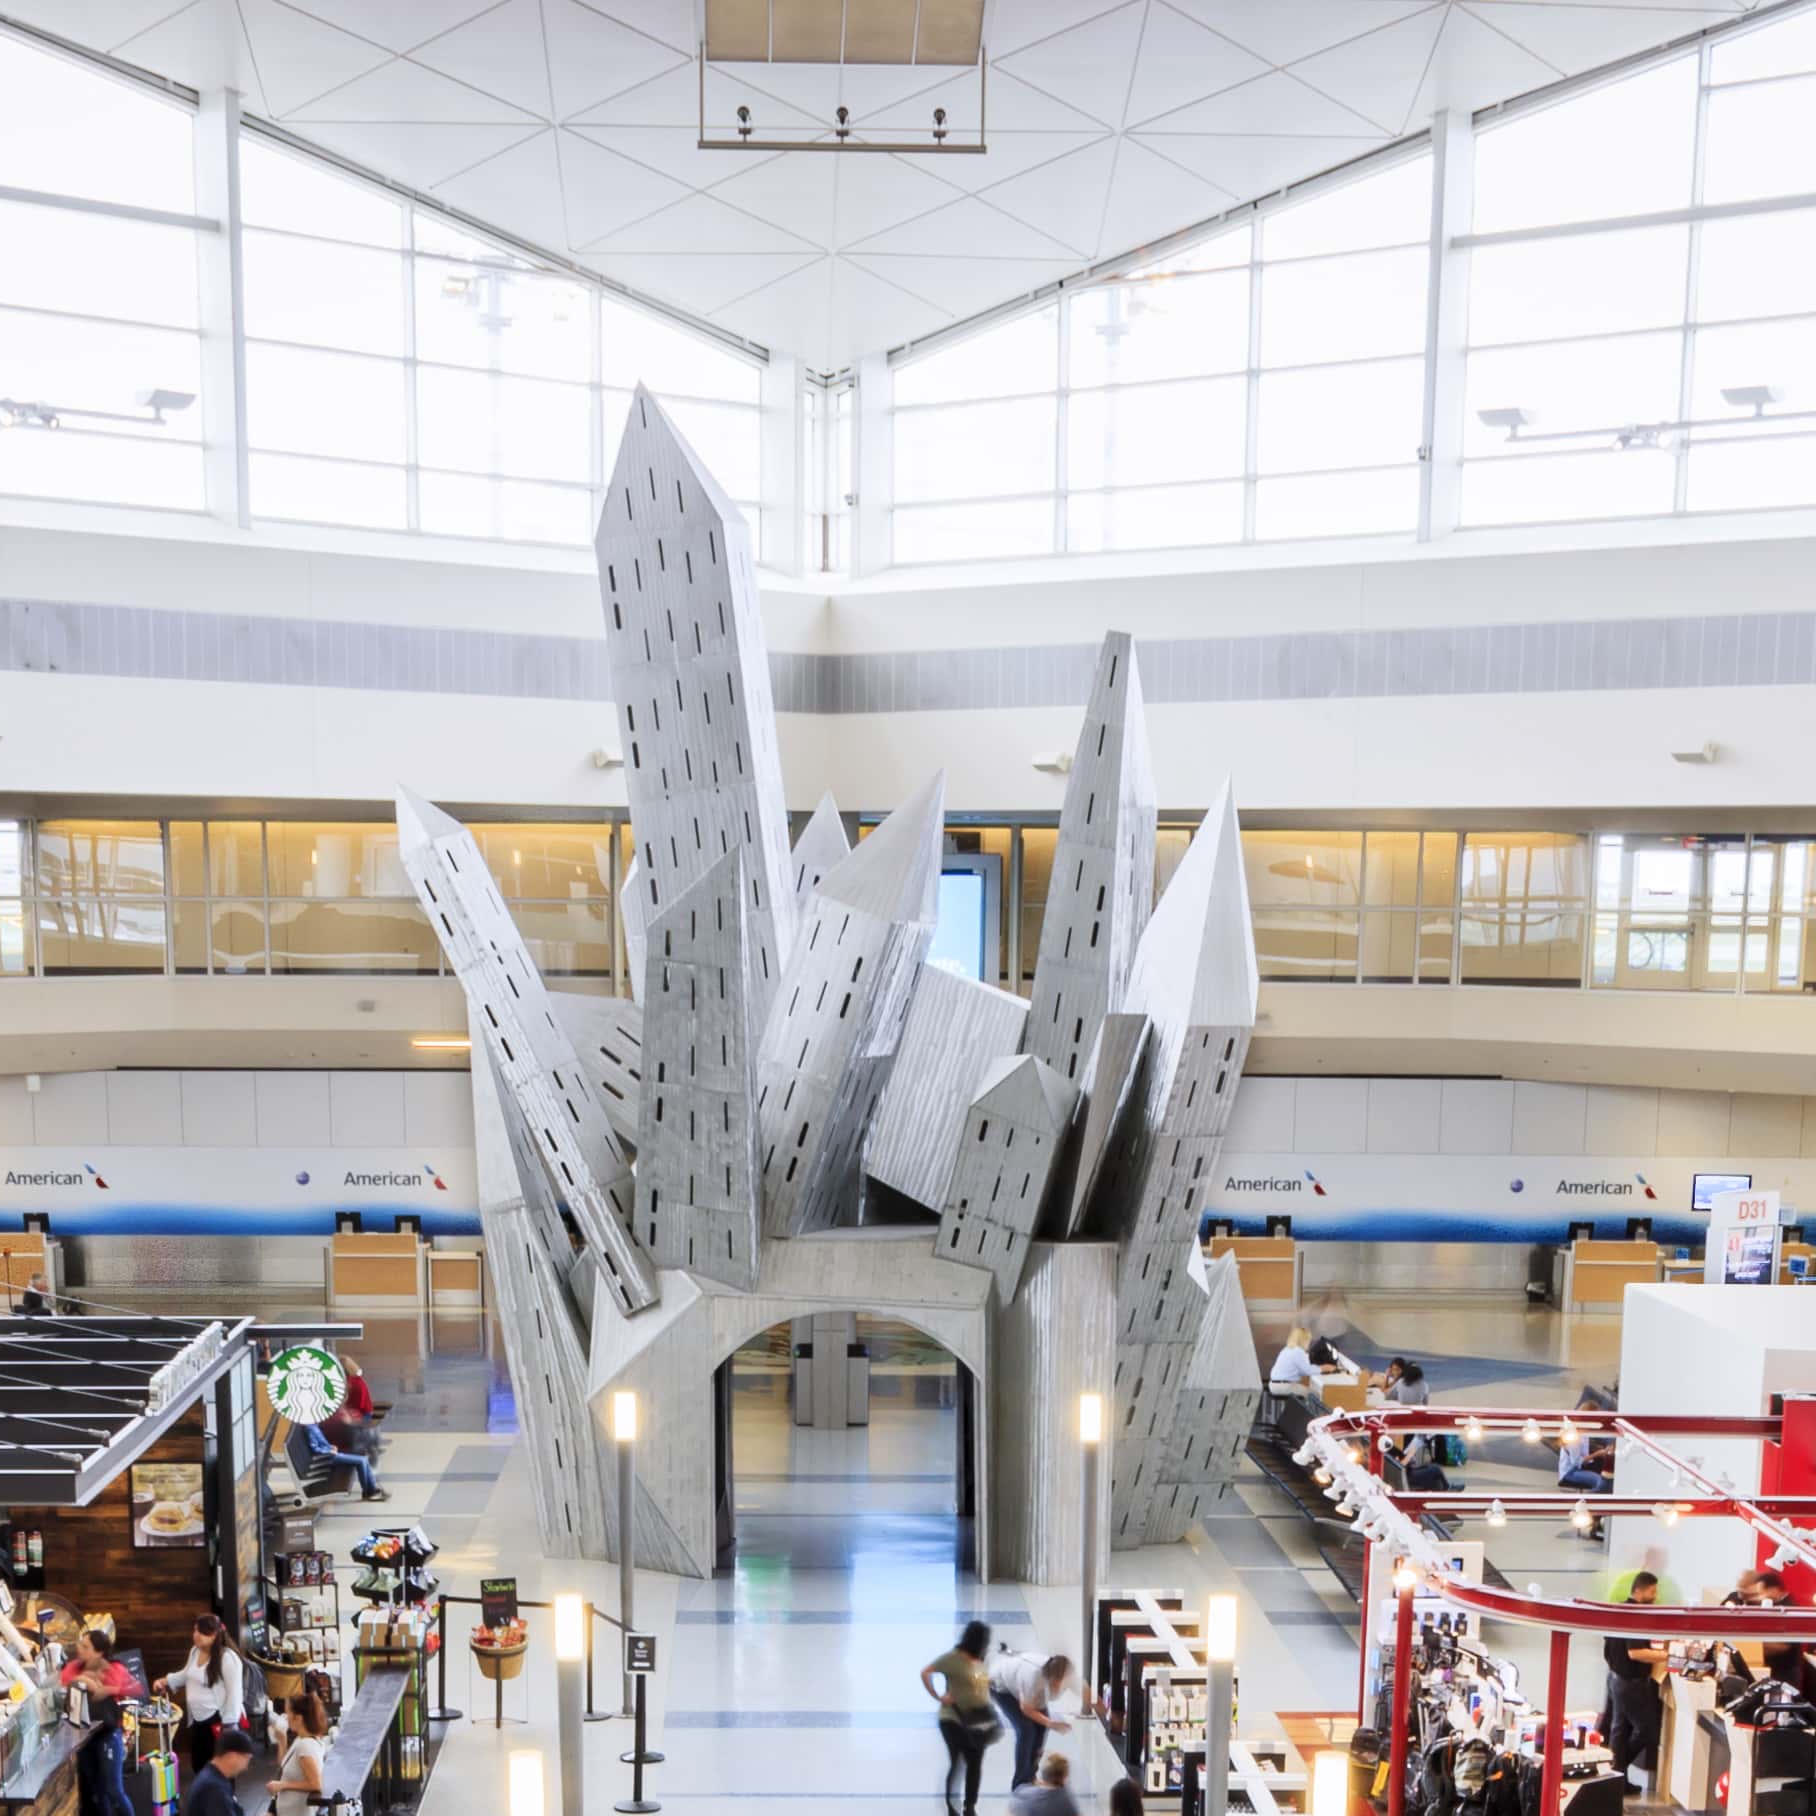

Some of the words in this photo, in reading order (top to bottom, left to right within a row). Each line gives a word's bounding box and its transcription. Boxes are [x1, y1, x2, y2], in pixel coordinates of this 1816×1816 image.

[4, 1171, 83, 1185] American
[344, 1171, 422, 1186] American
[1225, 1176, 1302, 1191] American
[1556, 1179, 1633, 1195] American
[1738, 1199, 1767, 1220] D31
